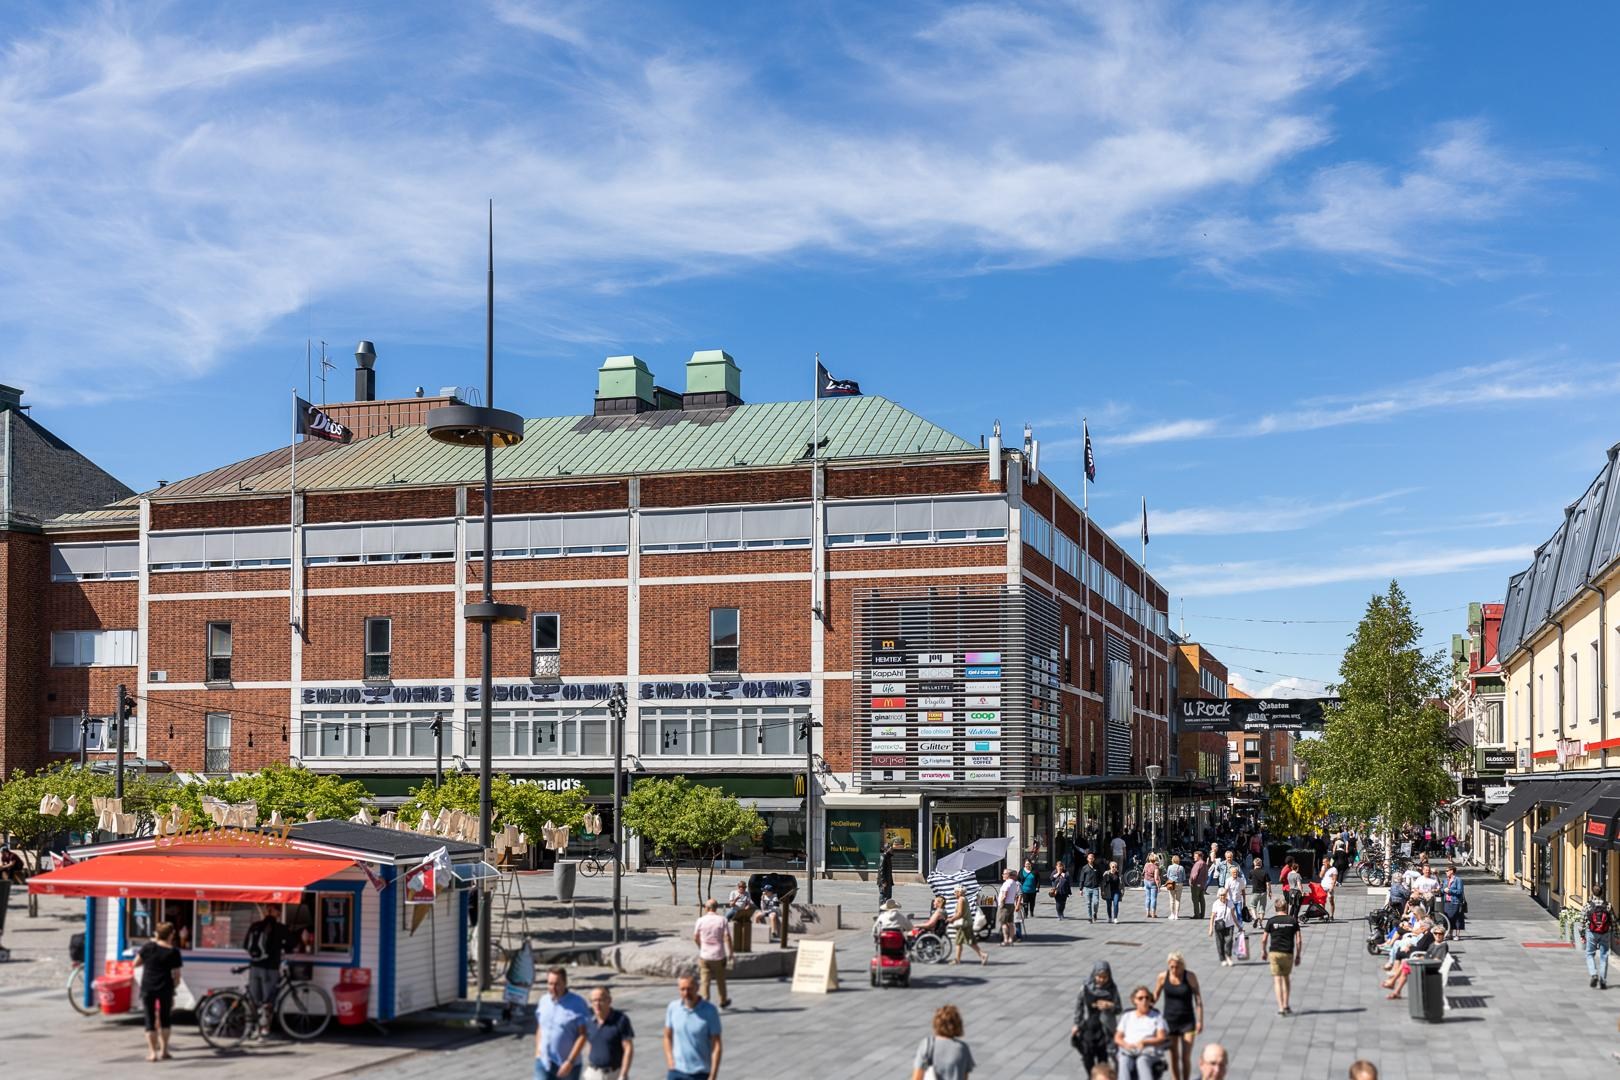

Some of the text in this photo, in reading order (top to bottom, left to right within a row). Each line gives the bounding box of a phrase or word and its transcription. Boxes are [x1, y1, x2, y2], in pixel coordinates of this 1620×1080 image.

[872, 670, 904, 678] KappAhl
[920, 668, 951, 676] KICKS
[1258, 700, 1290, 712] Sabaton
[971, 712, 996, 720] coop
[920, 742, 950, 750] Glitter
